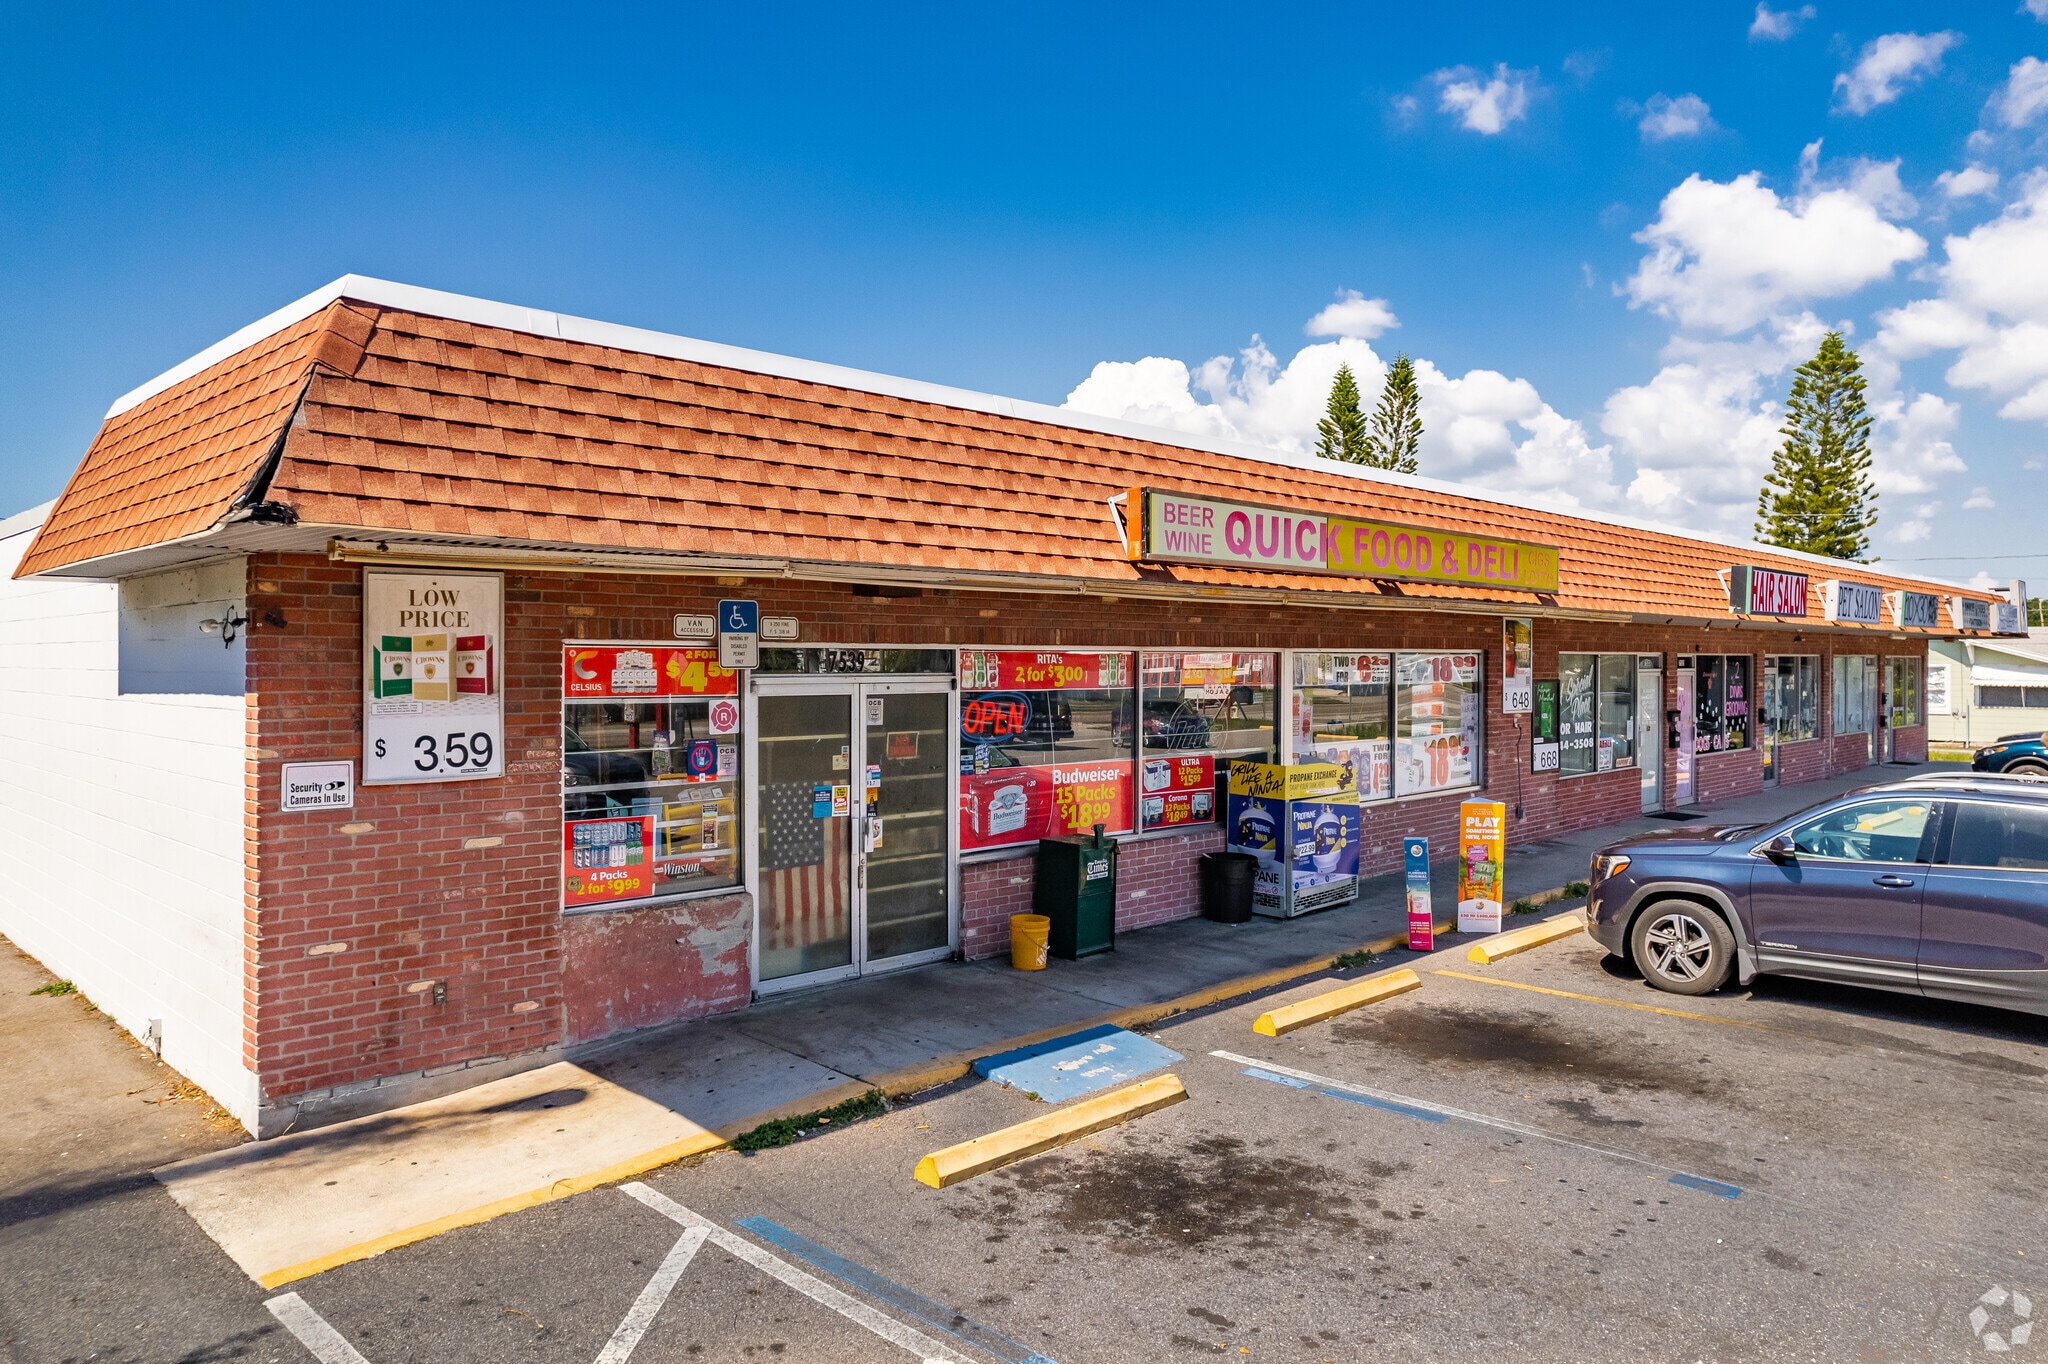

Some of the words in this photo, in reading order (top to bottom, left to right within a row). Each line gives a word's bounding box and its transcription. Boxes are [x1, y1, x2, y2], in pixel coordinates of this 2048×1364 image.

[1163, 502, 1215, 529] BEER
[1164, 529, 1213, 555] WINE
[1225, 511, 1343, 564] QUICK
[1354, 527, 1432, 571] FOOD
[1441, 540, 1459, 574] &
[1467, 543, 1519, 582] DELI
[1528, 550, 1551, 568] CIGS
[1523, 569, 1555, 587] LOTTO
[408, 589, 461, 607] LOW
[1751, 570, 1775, 612] HAIR
[1777, 575, 1807, 615] SALON
[1838, 586, 1854, 617] PET
[1854, 588, 1881, 620] SALON
[399, 611, 470, 628] PRICE
[384, 655, 411, 664] CROWNS
[415, 656, 445, 665] CROWNS
[685, 651, 693, 659] 2
[694, 650, 716, 659] FOR
[1036, 654, 1063, 664] RITA's
[828, 650, 865, 672] 7539
[1334, 656, 1350, 667] TWO
[1015, 666, 1025, 682] 2
[1027, 666, 1046, 682] for
[1734, 661, 1740, 679] 2
[1336, 671, 1349, 682] FOR
[570, 683, 602, 691] CELSIUS
[1729, 685, 1744, 699] DIVAS
[1725, 701, 1749, 717] GROOMING
[720, 712, 728, 721] R
[963, 701, 1026, 735] OPEN
[1574, 721, 1593, 734] HAIR
[1372, 744, 1390, 752] TWO
[1713, 734, 1730, 750] CAS
[375, 737, 387, 759] $
[414, 732, 493, 772] 3.59
[1374, 752, 1388, 760] FOR
[1180, 758, 1200, 766] ULTRA
[1053, 767, 1120, 785] Budweiser
[1178, 767, 1185, 775] 12
[1186, 766, 1203, 775] Packs
[1231, 763, 1260, 777] GRILL
[1289, 772, 1313, 783] PROPANE
[1313, 769, 1338, 781] EXCHANGE
[1240, 772, 1263, 785] LIKE
[1265, 770, 1274, 781] A
[290, 782, 323, 793] Security
[1056, 786, 1073, 804] 15
[1076, 783, 1116, 802] Packs
[1247, 778, 1286, 797] NINJA!
[290, 795, 322, 805] Cameras
[323, 793, 331, 803] In
[332, 793, 346, 803] Use
[1168, 794, 1188, 803] Corona
[1165, 803, 1172, 811] 12
[1173, 803, 1190, 811] Packs
[993, 808, 1022, 820] Budweiser
[1293, 810, 1317, 822] PROPANE
[1251, 822, 1271, 834] PROPANE
[1297, 821, 1313, 831] NINJA
[1465, 816, 1501, 828] PLAY
[1255, 832, 1268, 842] NINJA
[1323, 827, 1338, 836] PROPANE
[663, 863, 700, 875] Winston
[590, 873, 598, 881] 4
[599, 870, 628, 881] Packs
[588, 882, 605, 894] for
